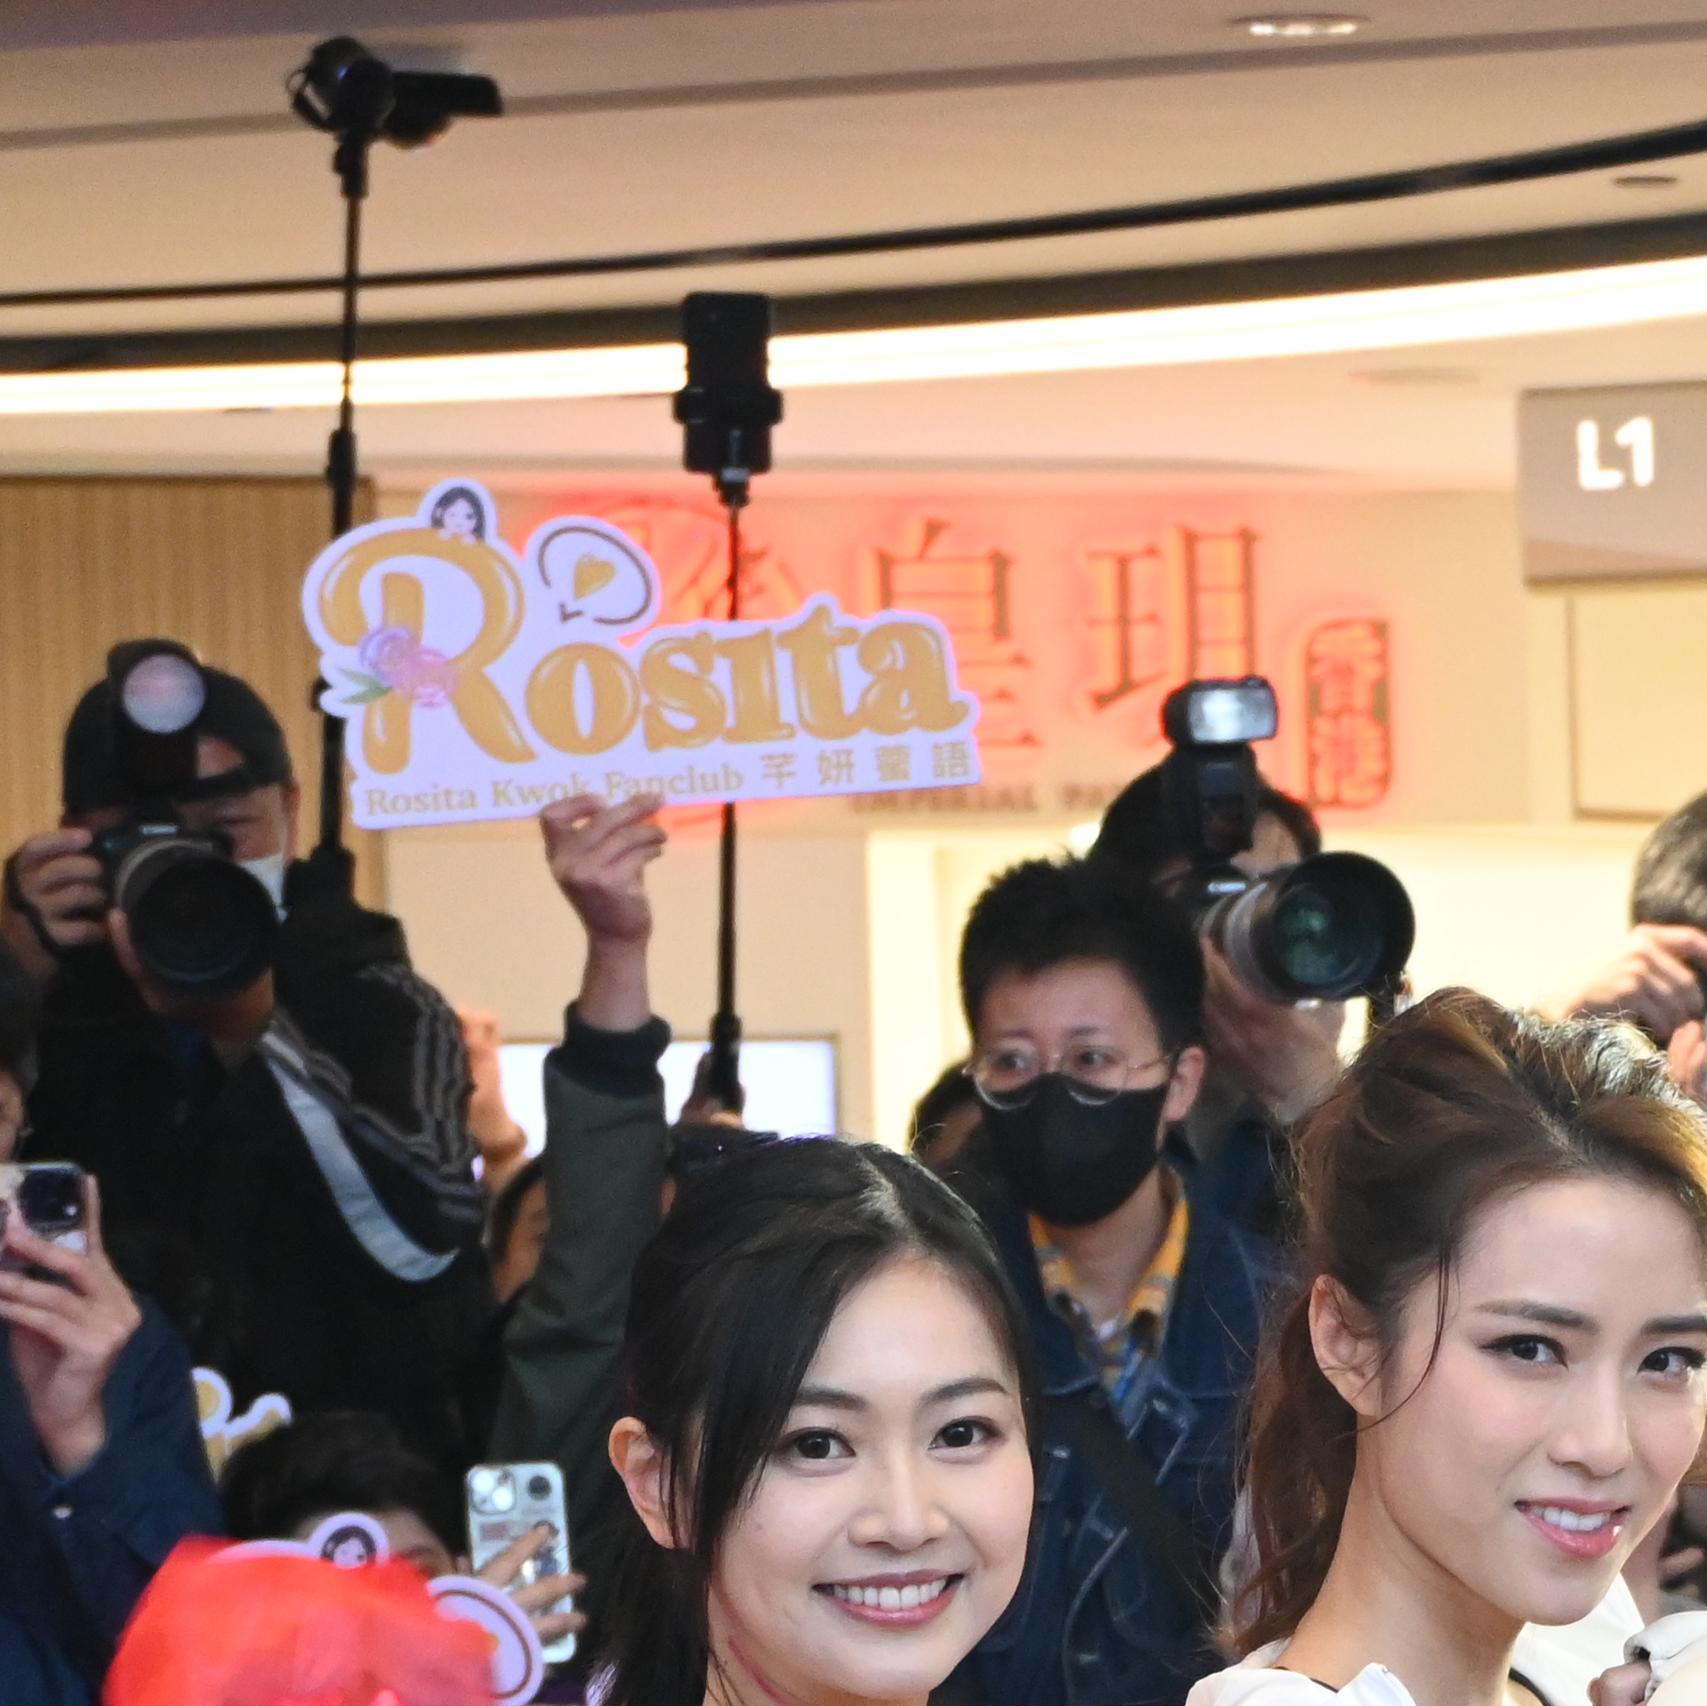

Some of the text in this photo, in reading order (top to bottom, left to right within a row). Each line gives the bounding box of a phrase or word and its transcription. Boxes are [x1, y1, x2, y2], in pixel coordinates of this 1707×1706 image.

[1577, 417, 1654, 491] L1
[366, 763, 744, 817] Rosita Kwok Fanclub
